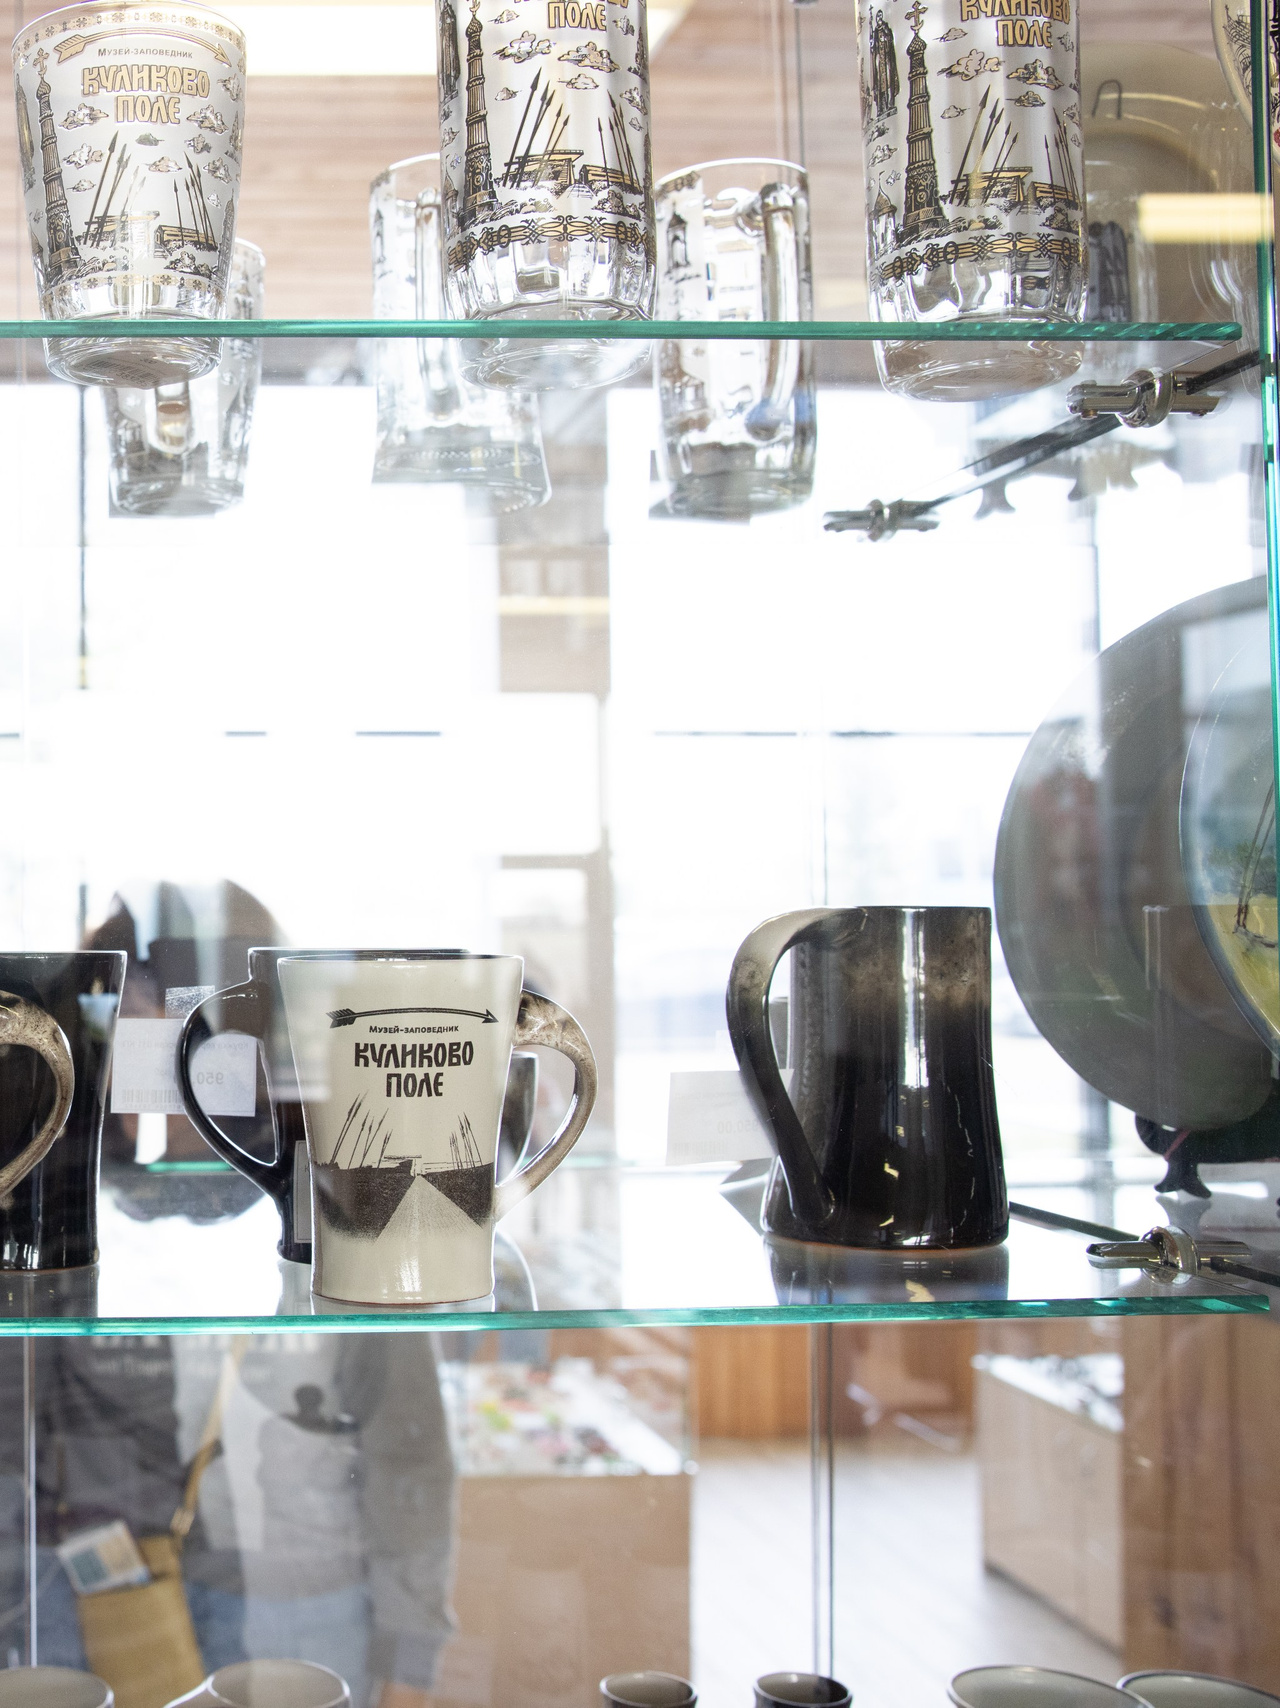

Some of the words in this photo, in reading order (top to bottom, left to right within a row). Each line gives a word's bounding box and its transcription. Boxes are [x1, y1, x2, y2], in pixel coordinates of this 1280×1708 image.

[548, 2, 607, 31] ПОЛЕ
[996, 19, 1053, 48] ПОЛЕ
[82, 64, 210, 98] КУЛИКОВО
[115, 95, 181, 124] ПОЛЕ
[354, 1041, 474, 1069] КУЛИКОВО
[386, 1072, 444, 1098] ПОЛЕ
